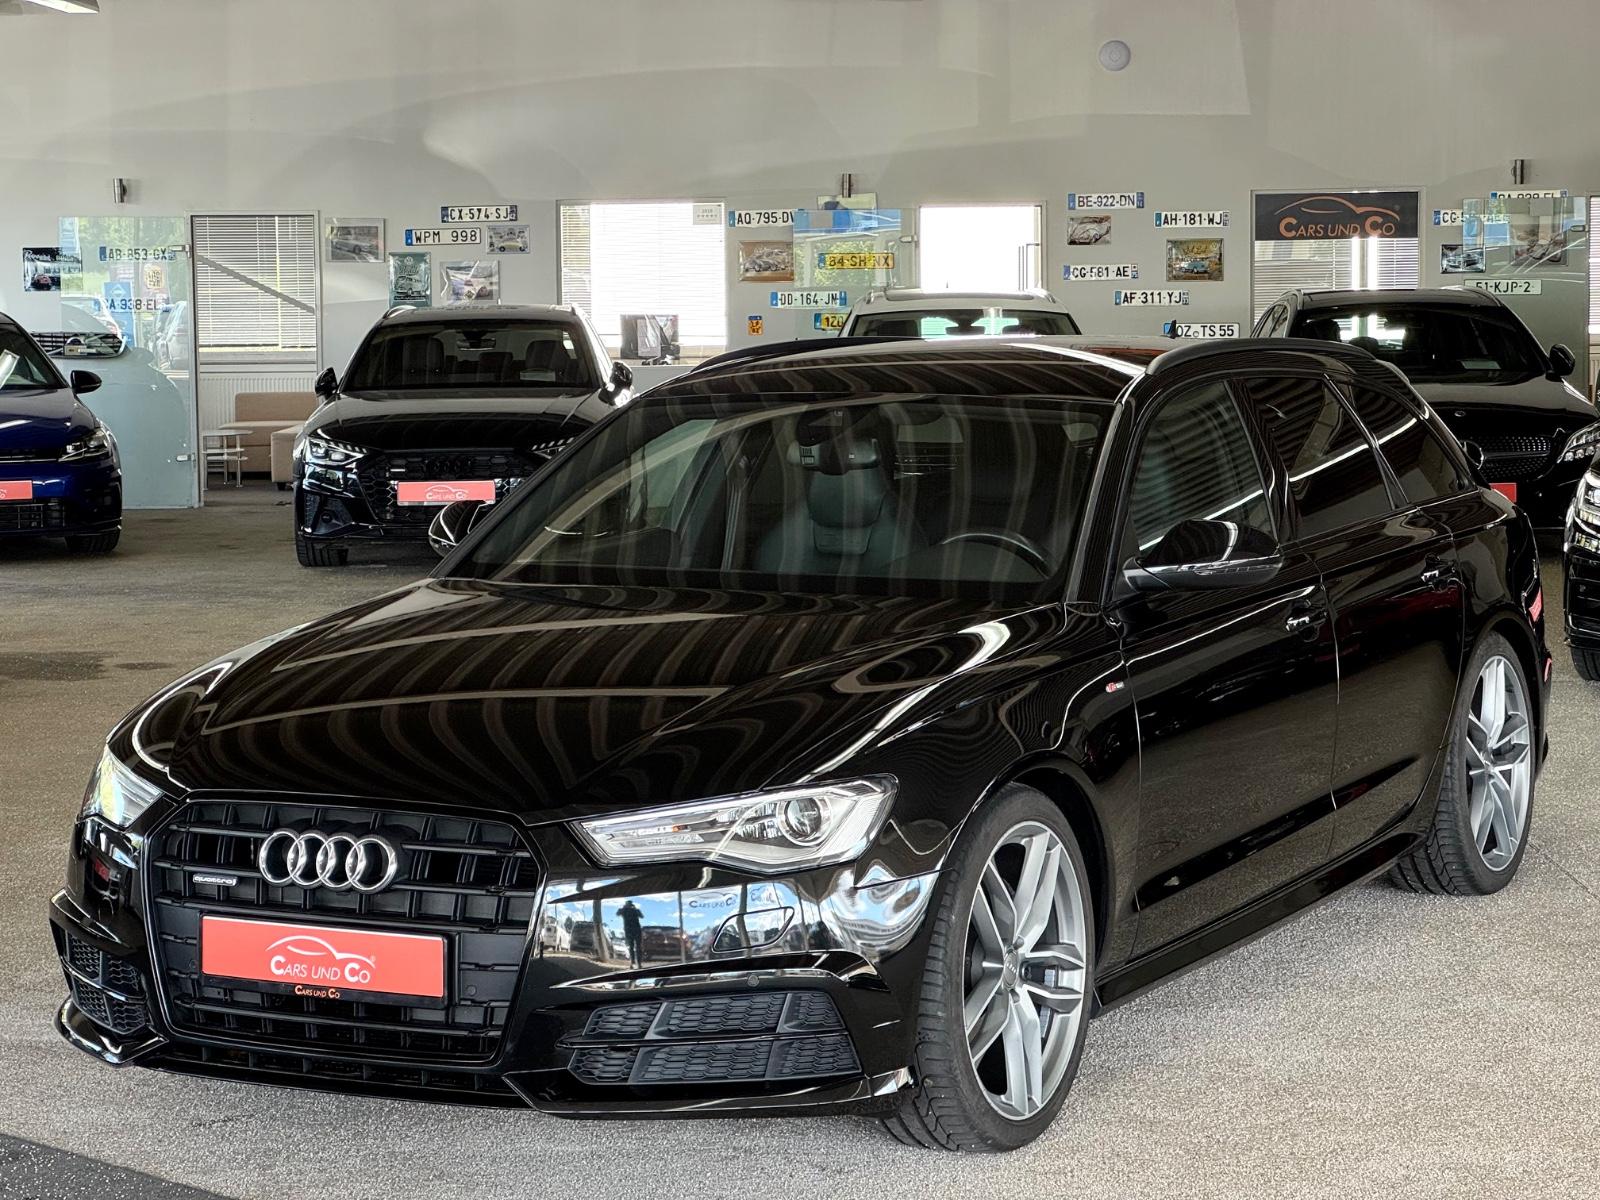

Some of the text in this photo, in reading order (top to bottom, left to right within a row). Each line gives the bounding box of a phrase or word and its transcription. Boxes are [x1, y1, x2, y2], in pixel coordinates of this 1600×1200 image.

[1077, 194, 1135, 208] BE-922-DN
[449, 207, 509, 220] CX-574-SJ
[1162, 213, 1222, 226] AH-181-WJ
[1279, 215, 1395, 238] CARS UND CO
[414, 230, 478, 243] WPM 998
[1476, 281, 1531, 293] 51-KJP-2
[106, 298, 159, 311] A-938-EL
[1122, 292, 1182, 304] AF-311-YJ
[1200, 325, 1216, 338] TS
[1219, 324, 1234, 337] 55
[194, 876, 233, 885] quattro
[270, 955, 371, 984] CARS UND CO
[294, 985, 341, 999] CARS UND CO
